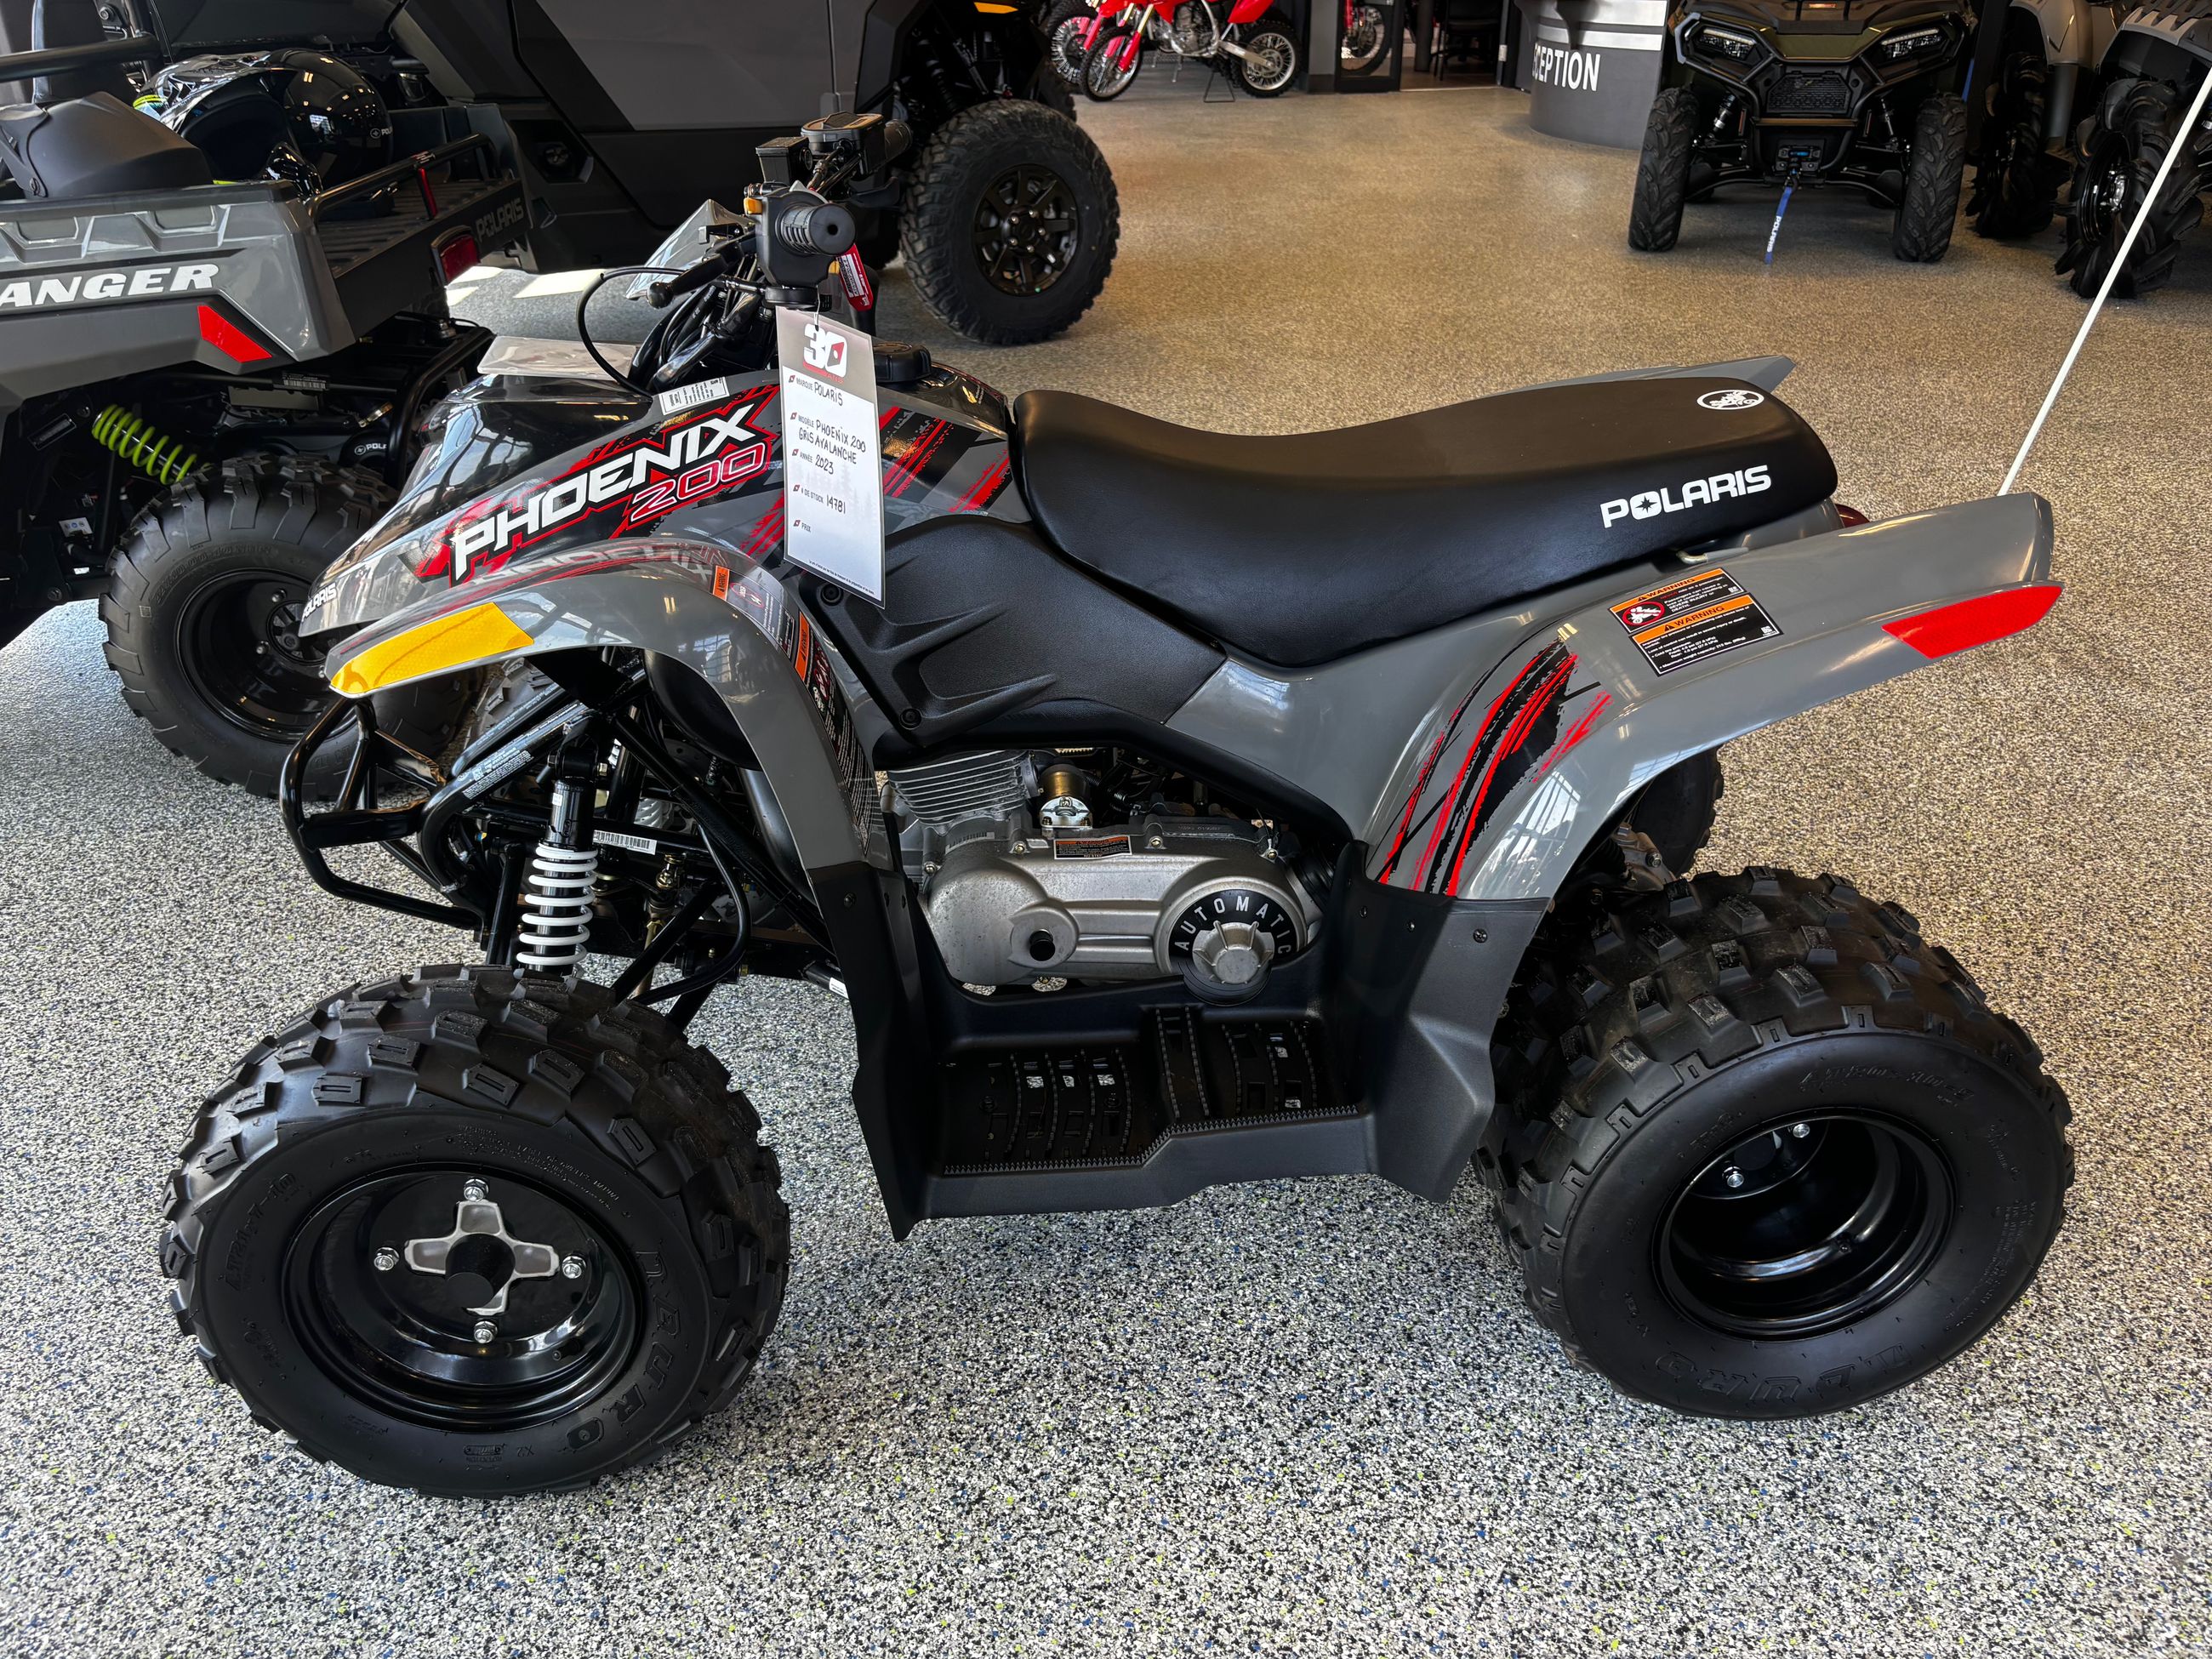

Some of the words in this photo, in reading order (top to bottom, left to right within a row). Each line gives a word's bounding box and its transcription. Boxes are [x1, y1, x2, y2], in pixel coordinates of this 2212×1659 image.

[476, 197, 524, 243] POLARIS
[1766, 215, 1782, 253] POLARIS
[796, 377, 813, 391] MARQUE
[850, 436, 866, 453] 200
[800, 452, 813, 465] ANNÉE
[815, 454, 834, 475] 2023
[451, 404, 755, 580] PHOENIX
[630, 442, 766, 522] 200
[1599, 465, 1772, 528] POLARIS
[804, 488, 810, 497] DE
[810, 491, 824, 504] STOCK
[827, 493, 846, 515] 14781
[801, 522, 812, 533] PRIX
[301, 582, 337, 622] POLARIS
[1647, 578, 1696, 598] WARNING
[1674, 605, 1725, 628] WARNING
[1174, 895, 1291, 955] AUTOMATIC
